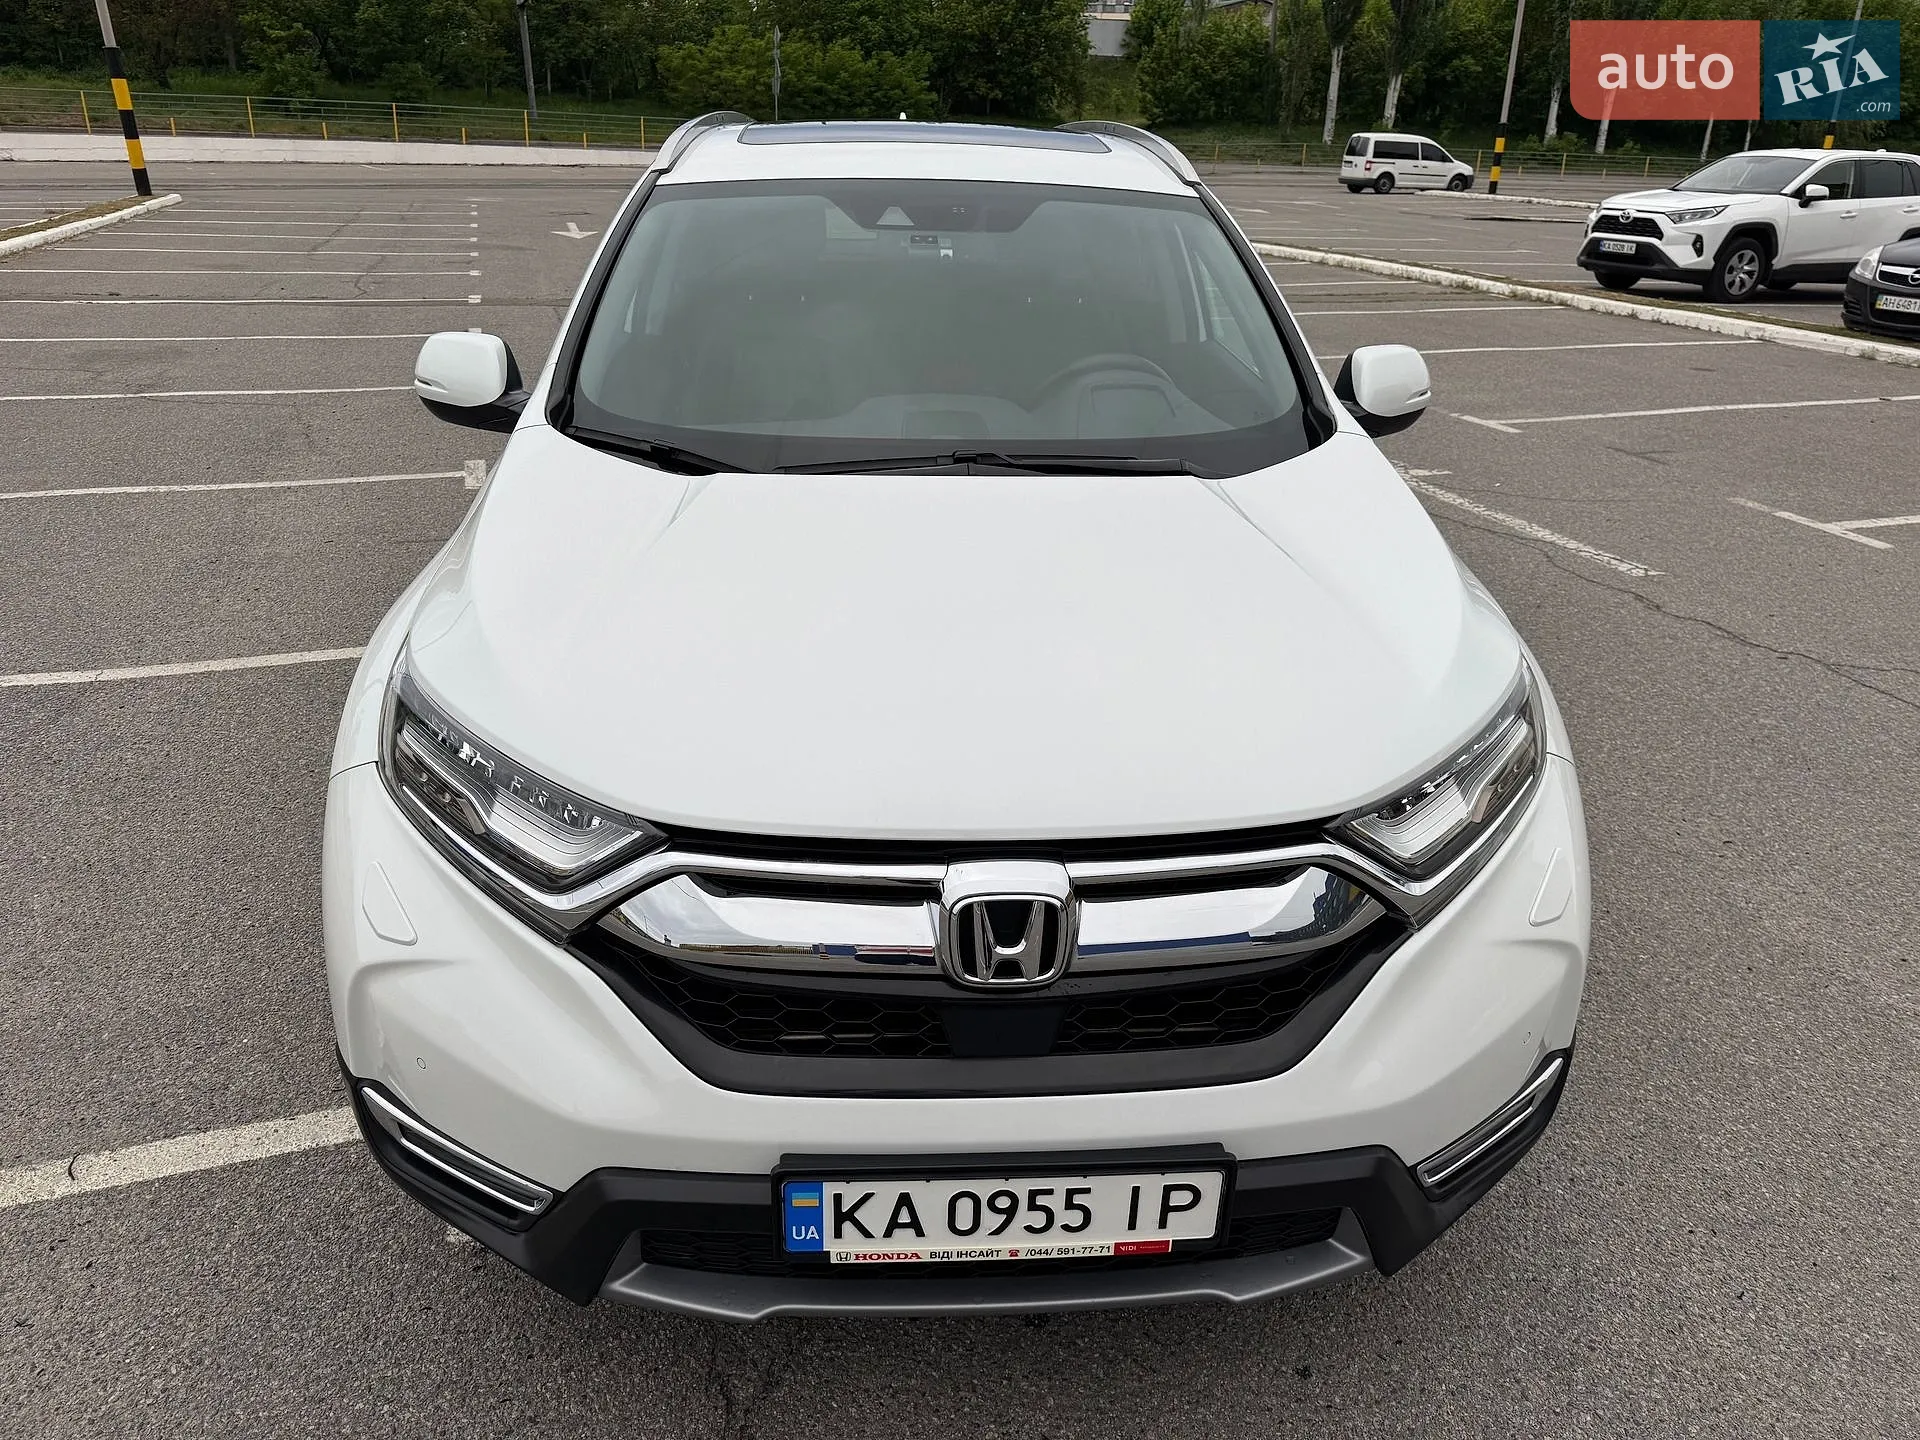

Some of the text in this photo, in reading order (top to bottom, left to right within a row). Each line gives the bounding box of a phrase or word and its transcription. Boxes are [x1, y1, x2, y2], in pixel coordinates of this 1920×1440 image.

[792, 1183, 1202, 1240] UA KA 0955 IP
[853, 1252, 923, 1261] HONDA
[956, 1249, 1002, 1259] ІНСАЙТ
[1025, 1248, 1054, 1257] /044/
[1057, 1245, 1111, 1256] 591-77-71
